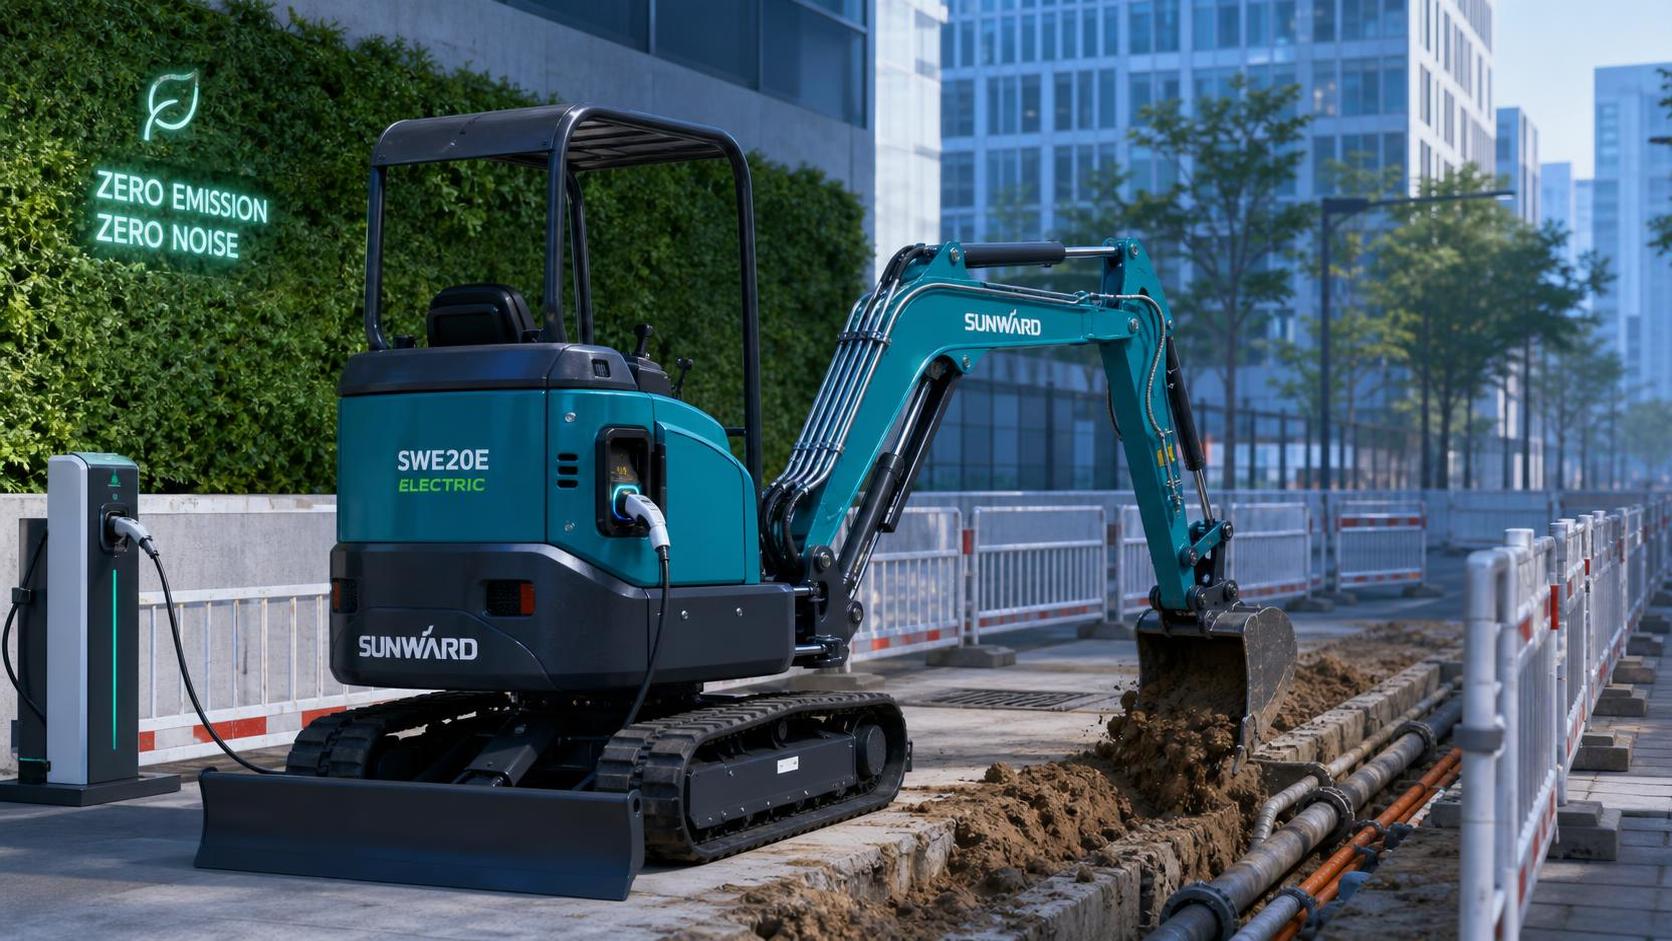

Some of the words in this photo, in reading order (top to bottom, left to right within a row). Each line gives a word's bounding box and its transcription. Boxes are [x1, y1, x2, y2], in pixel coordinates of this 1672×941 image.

[96, 169, 164, 207] ZERO
[172, 183, 268, 224] EMISSION
[96, 213, 164, 248] ZERO
[172, 224, 239, 259] NOISE
[964, 309, 1041, 336] SUNWARD
[397, 449, 489, 472] SWE20E
[398, 478, 486, 492] ELECTRIC
[358, 624, 478, 661] SUNWARD
